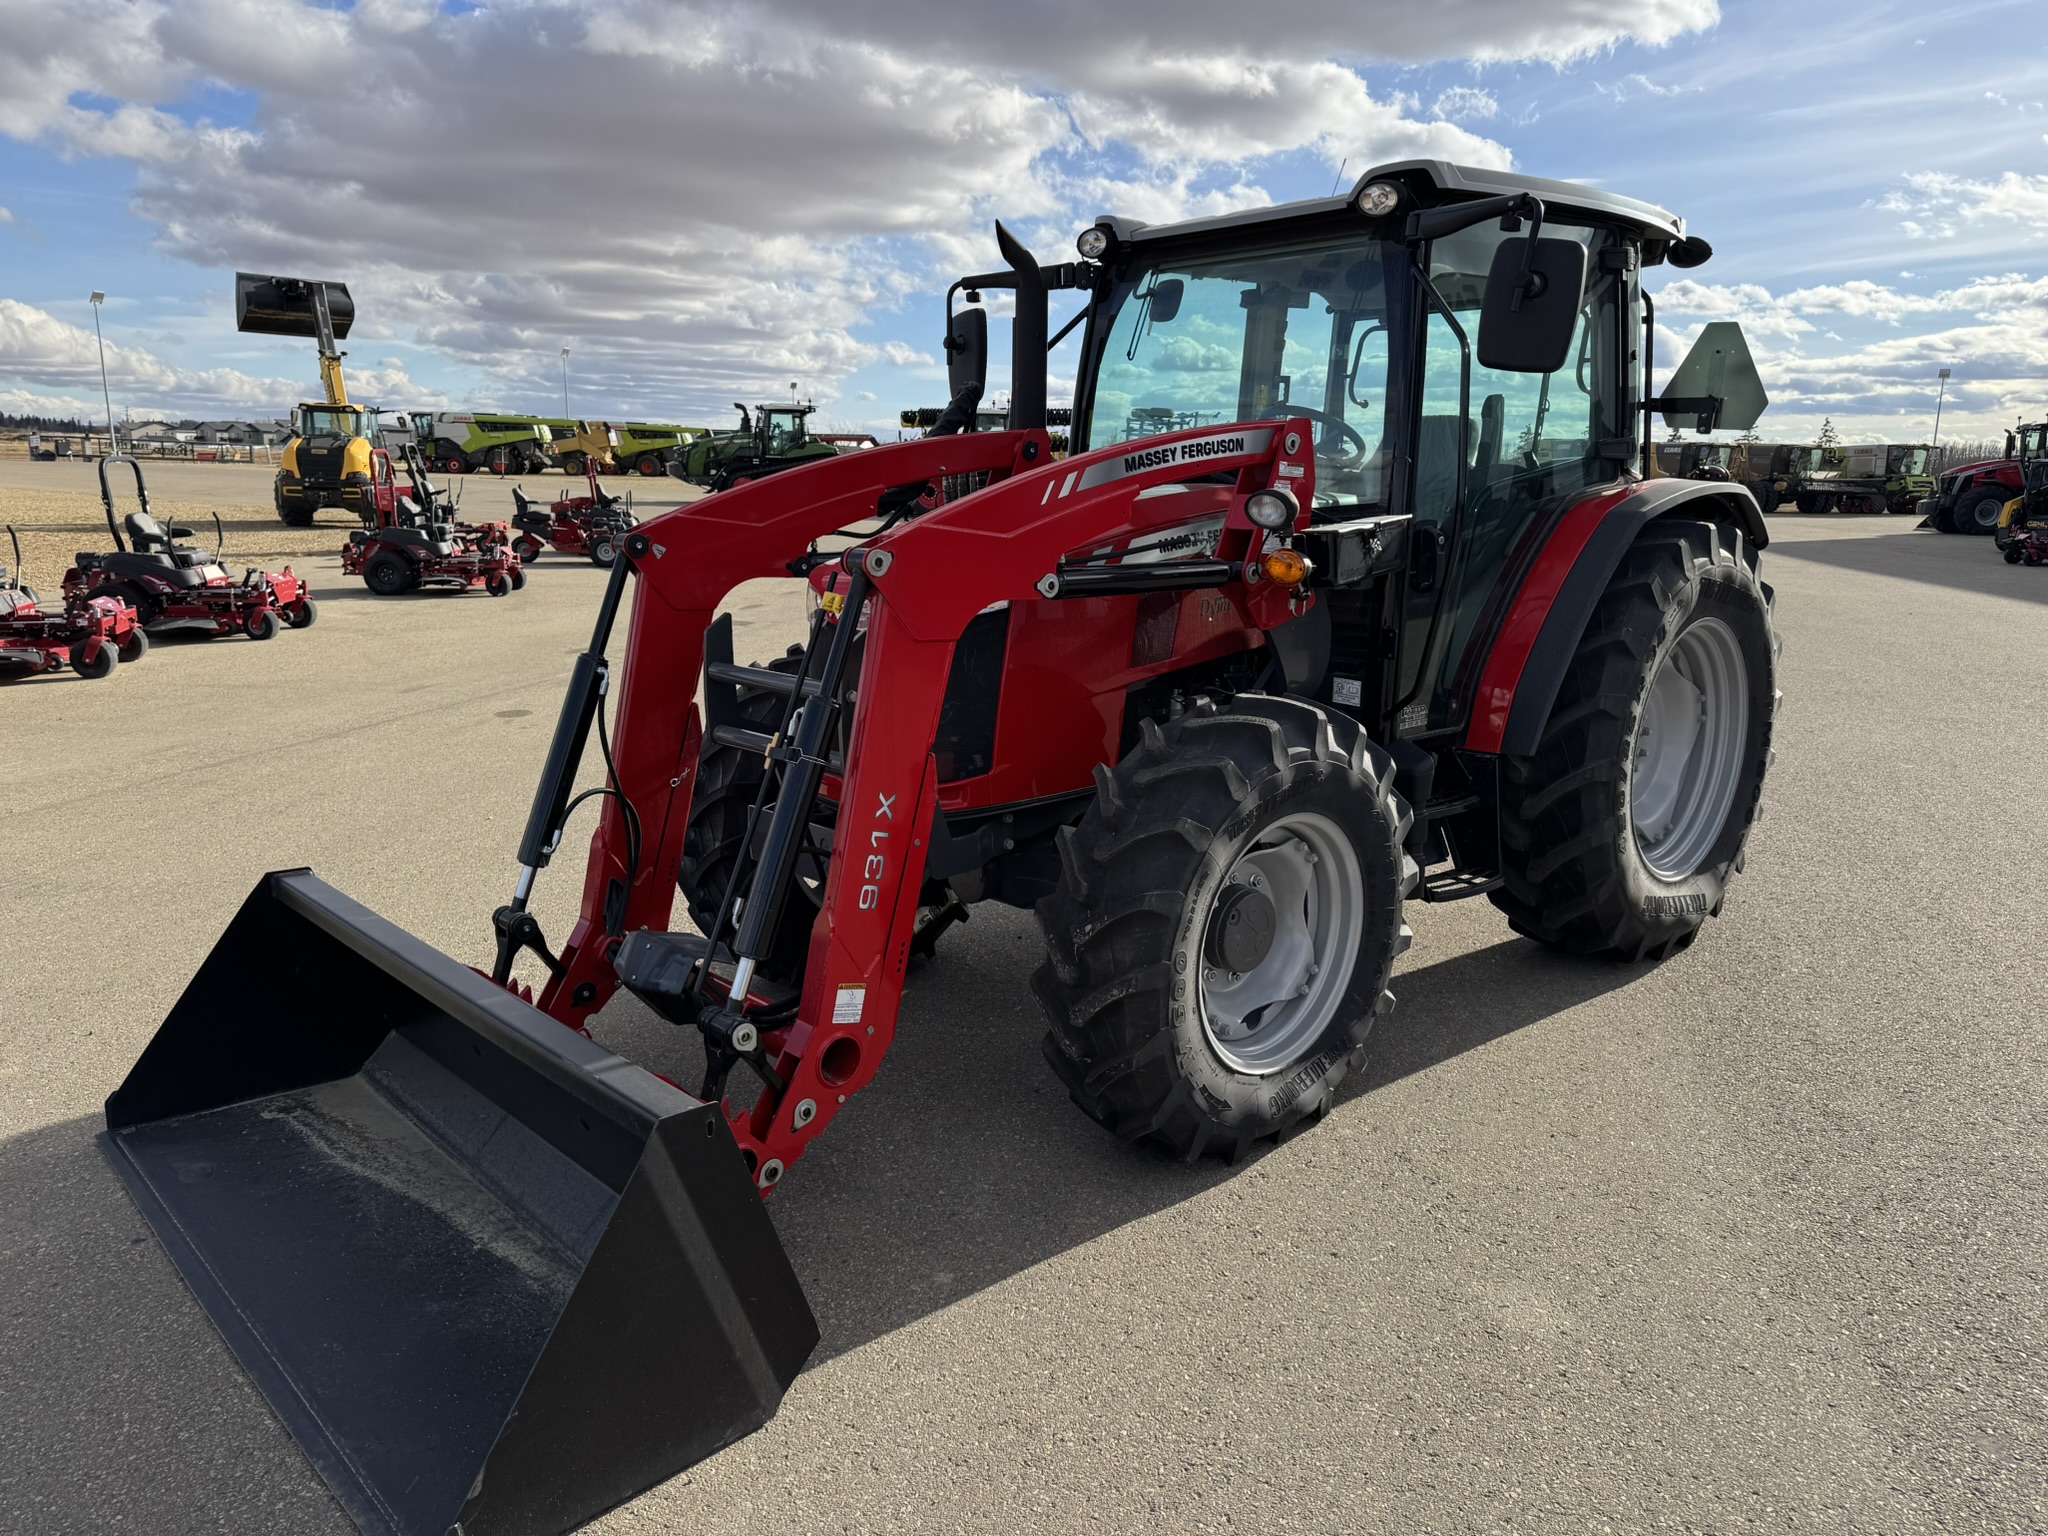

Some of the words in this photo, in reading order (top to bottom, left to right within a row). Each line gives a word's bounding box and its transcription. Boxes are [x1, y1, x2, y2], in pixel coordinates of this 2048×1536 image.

[1124, 447, 1177, 473] MASSEY
[1181, 437, 1244, 460] FERGUSON
[1640, 893, 1708, 918] TRELLEBORG
[1267, 1036, 1352, 1120] TRELLEBORG
